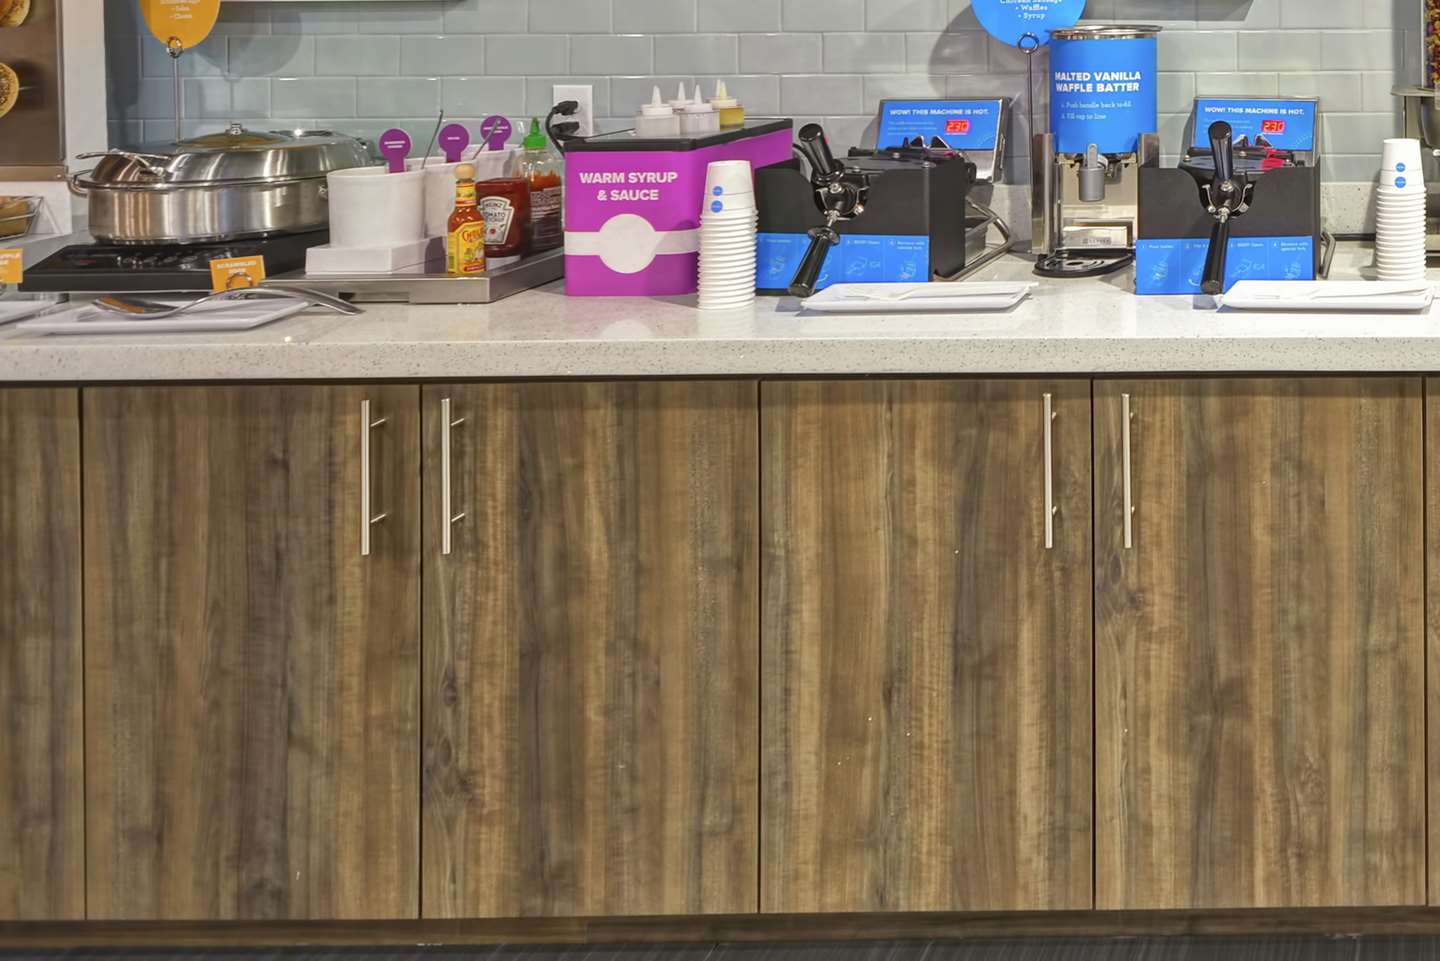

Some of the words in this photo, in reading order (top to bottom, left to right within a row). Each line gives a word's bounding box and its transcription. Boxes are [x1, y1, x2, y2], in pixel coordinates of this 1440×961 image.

[1055, 72, 1091, 81] MALTED
[1093, 71, 1142, 81] VANILLA
[1055, 83, 1093, 93] WAFFLE
[1096, 82, 1140, 92] BATTER
[1263, 120, 1284, 132] 230
[579, 172, 625, 183] WARM
[628, 171, 678, 183] SYRUP
[596, 189, 607, 201] &
[610, 189, 659, 200] SAUCE
